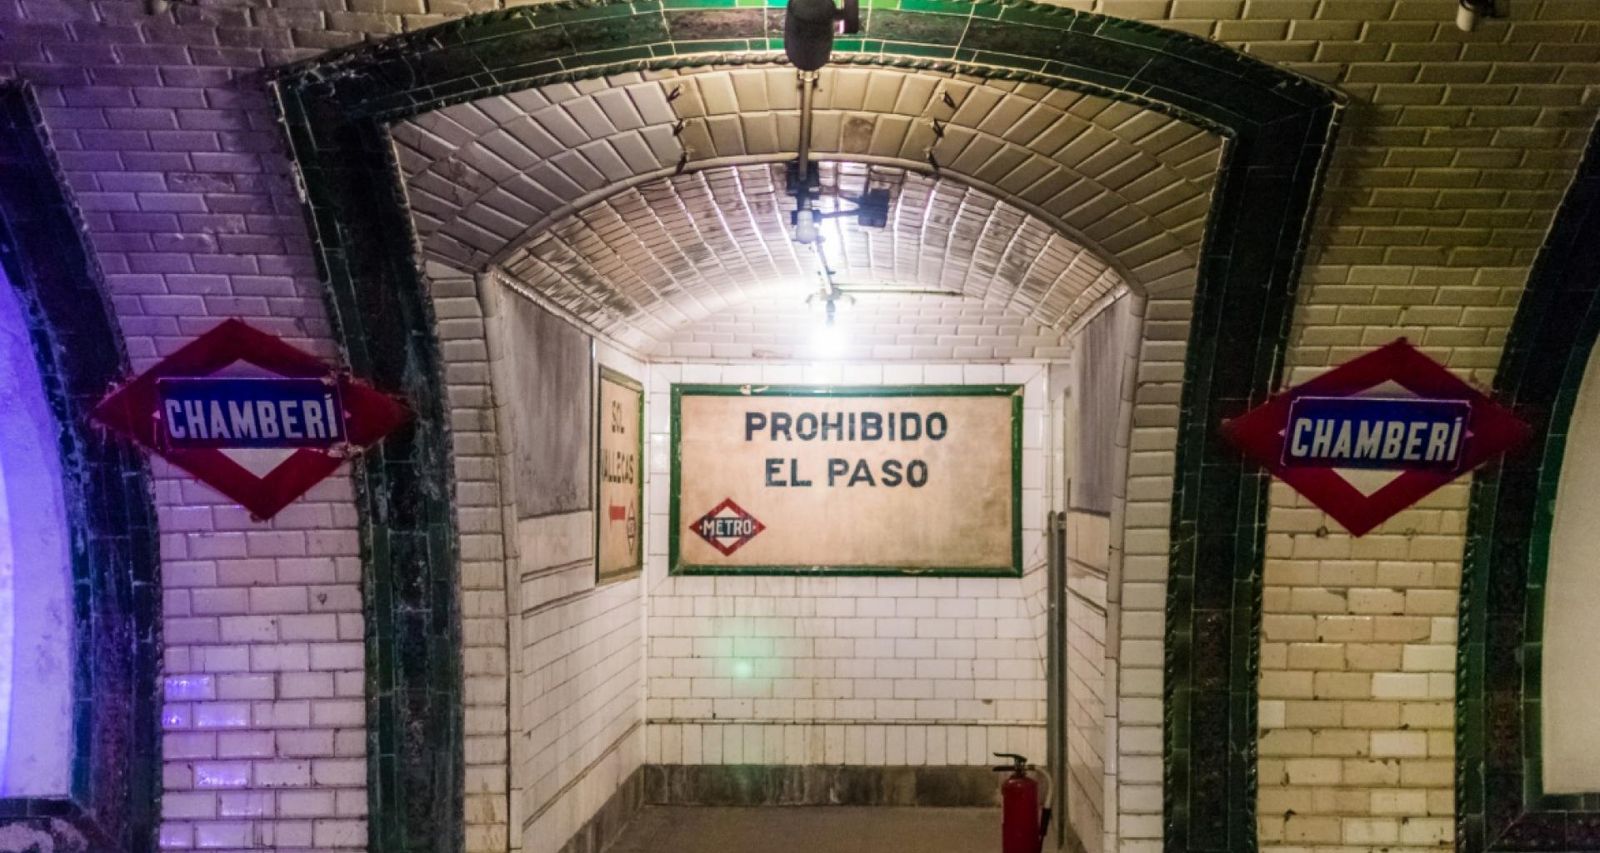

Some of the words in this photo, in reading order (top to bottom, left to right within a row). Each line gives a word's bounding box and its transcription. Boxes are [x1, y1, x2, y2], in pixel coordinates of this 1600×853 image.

[165, 394, 338, 439] CHAMBERÍ
[744, 411, 948, 441] PROHIBIDO
[1291, 416, 1462, 462] CHAMBERÍ
[765, 458, 812, 487] EL
[827, 459, 929, 488] PASO
[702, 518, 752, 536] METRO
